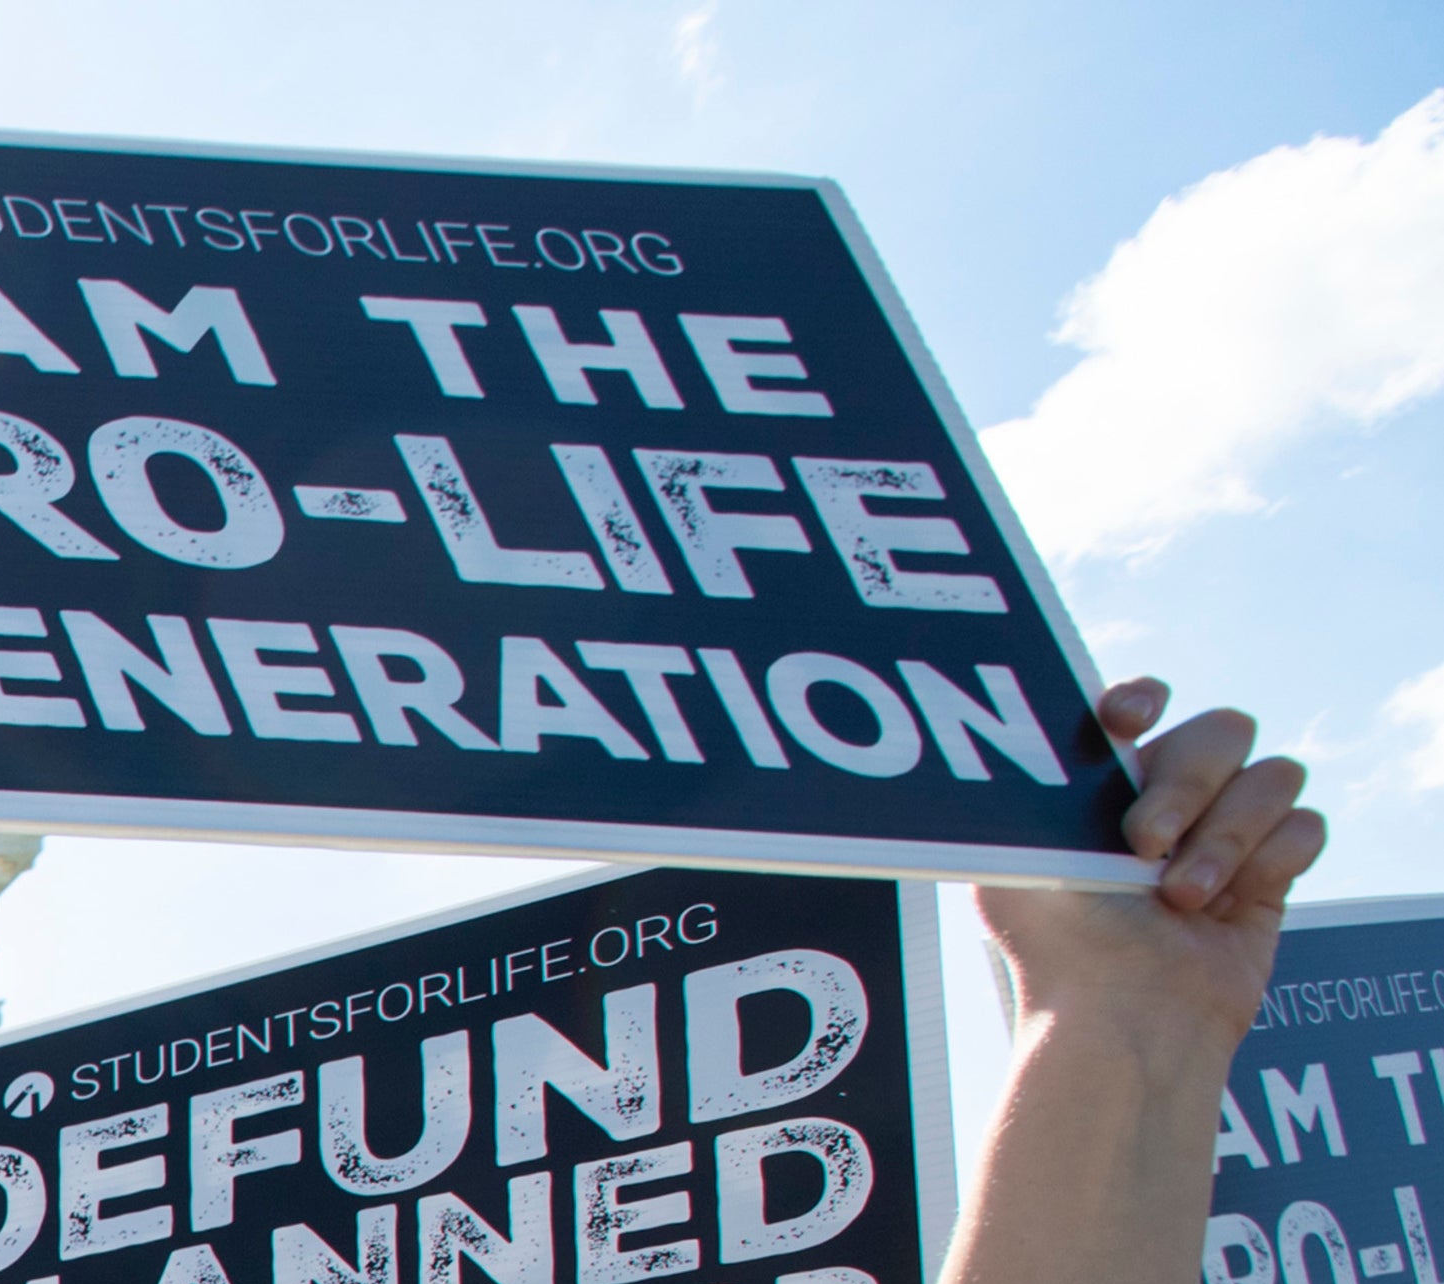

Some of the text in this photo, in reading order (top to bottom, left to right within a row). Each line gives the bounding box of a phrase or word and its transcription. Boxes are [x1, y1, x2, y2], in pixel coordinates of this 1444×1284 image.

[361, 294, 833, 418] THE
[70, 902, 720, 1102] STUDENTSFORLIFE.ORG
[1371, 1047, 1444, 1146] T
